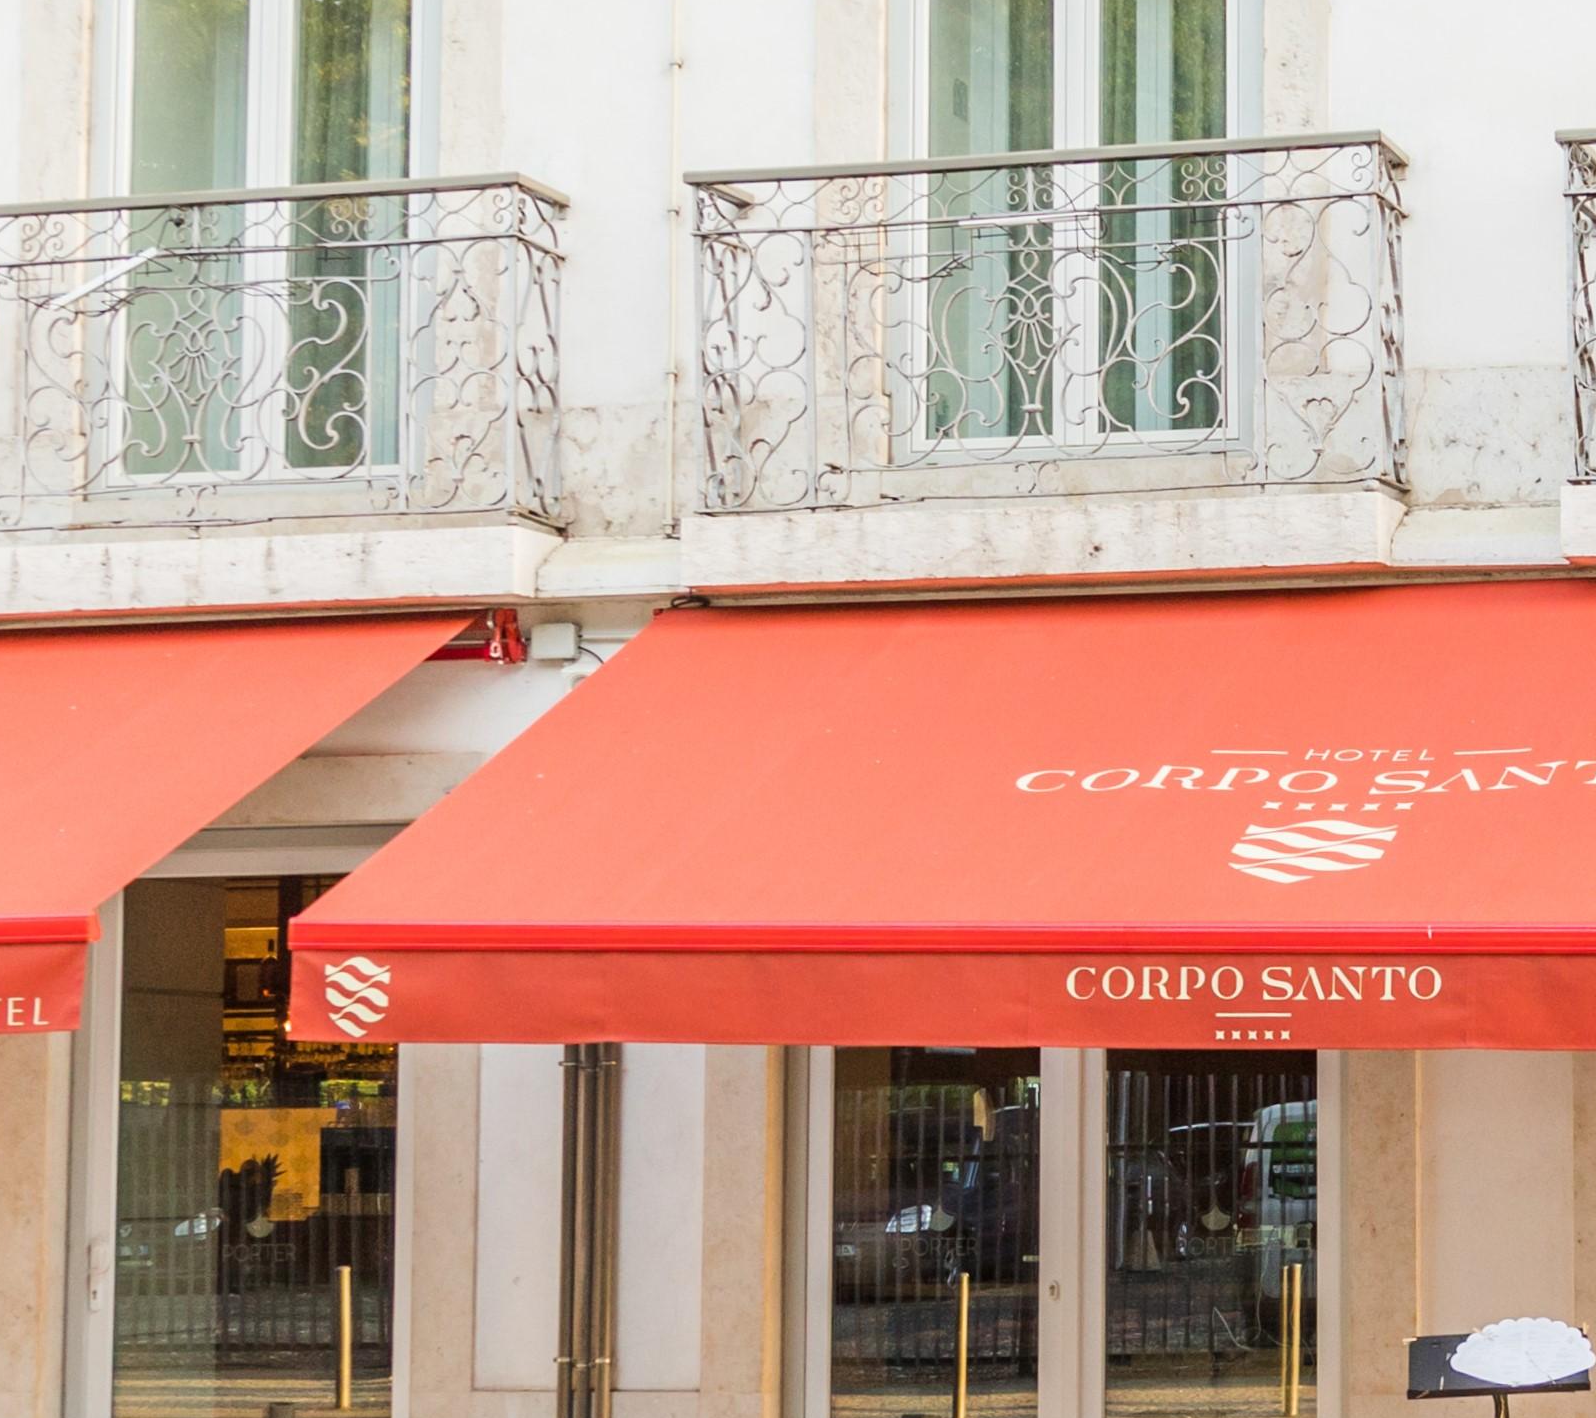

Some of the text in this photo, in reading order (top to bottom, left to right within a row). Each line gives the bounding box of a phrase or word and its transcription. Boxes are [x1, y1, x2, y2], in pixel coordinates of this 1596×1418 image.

[1304, 746, 1437, 765] HOTEL
[1013, 764, 1338, 795] CORPO
[1065, 964, 1443, 1001] CORPO SANTO
[223, 1243, 296, 1263] PORTER
[900, 1237, 978, 1257] PORTER
